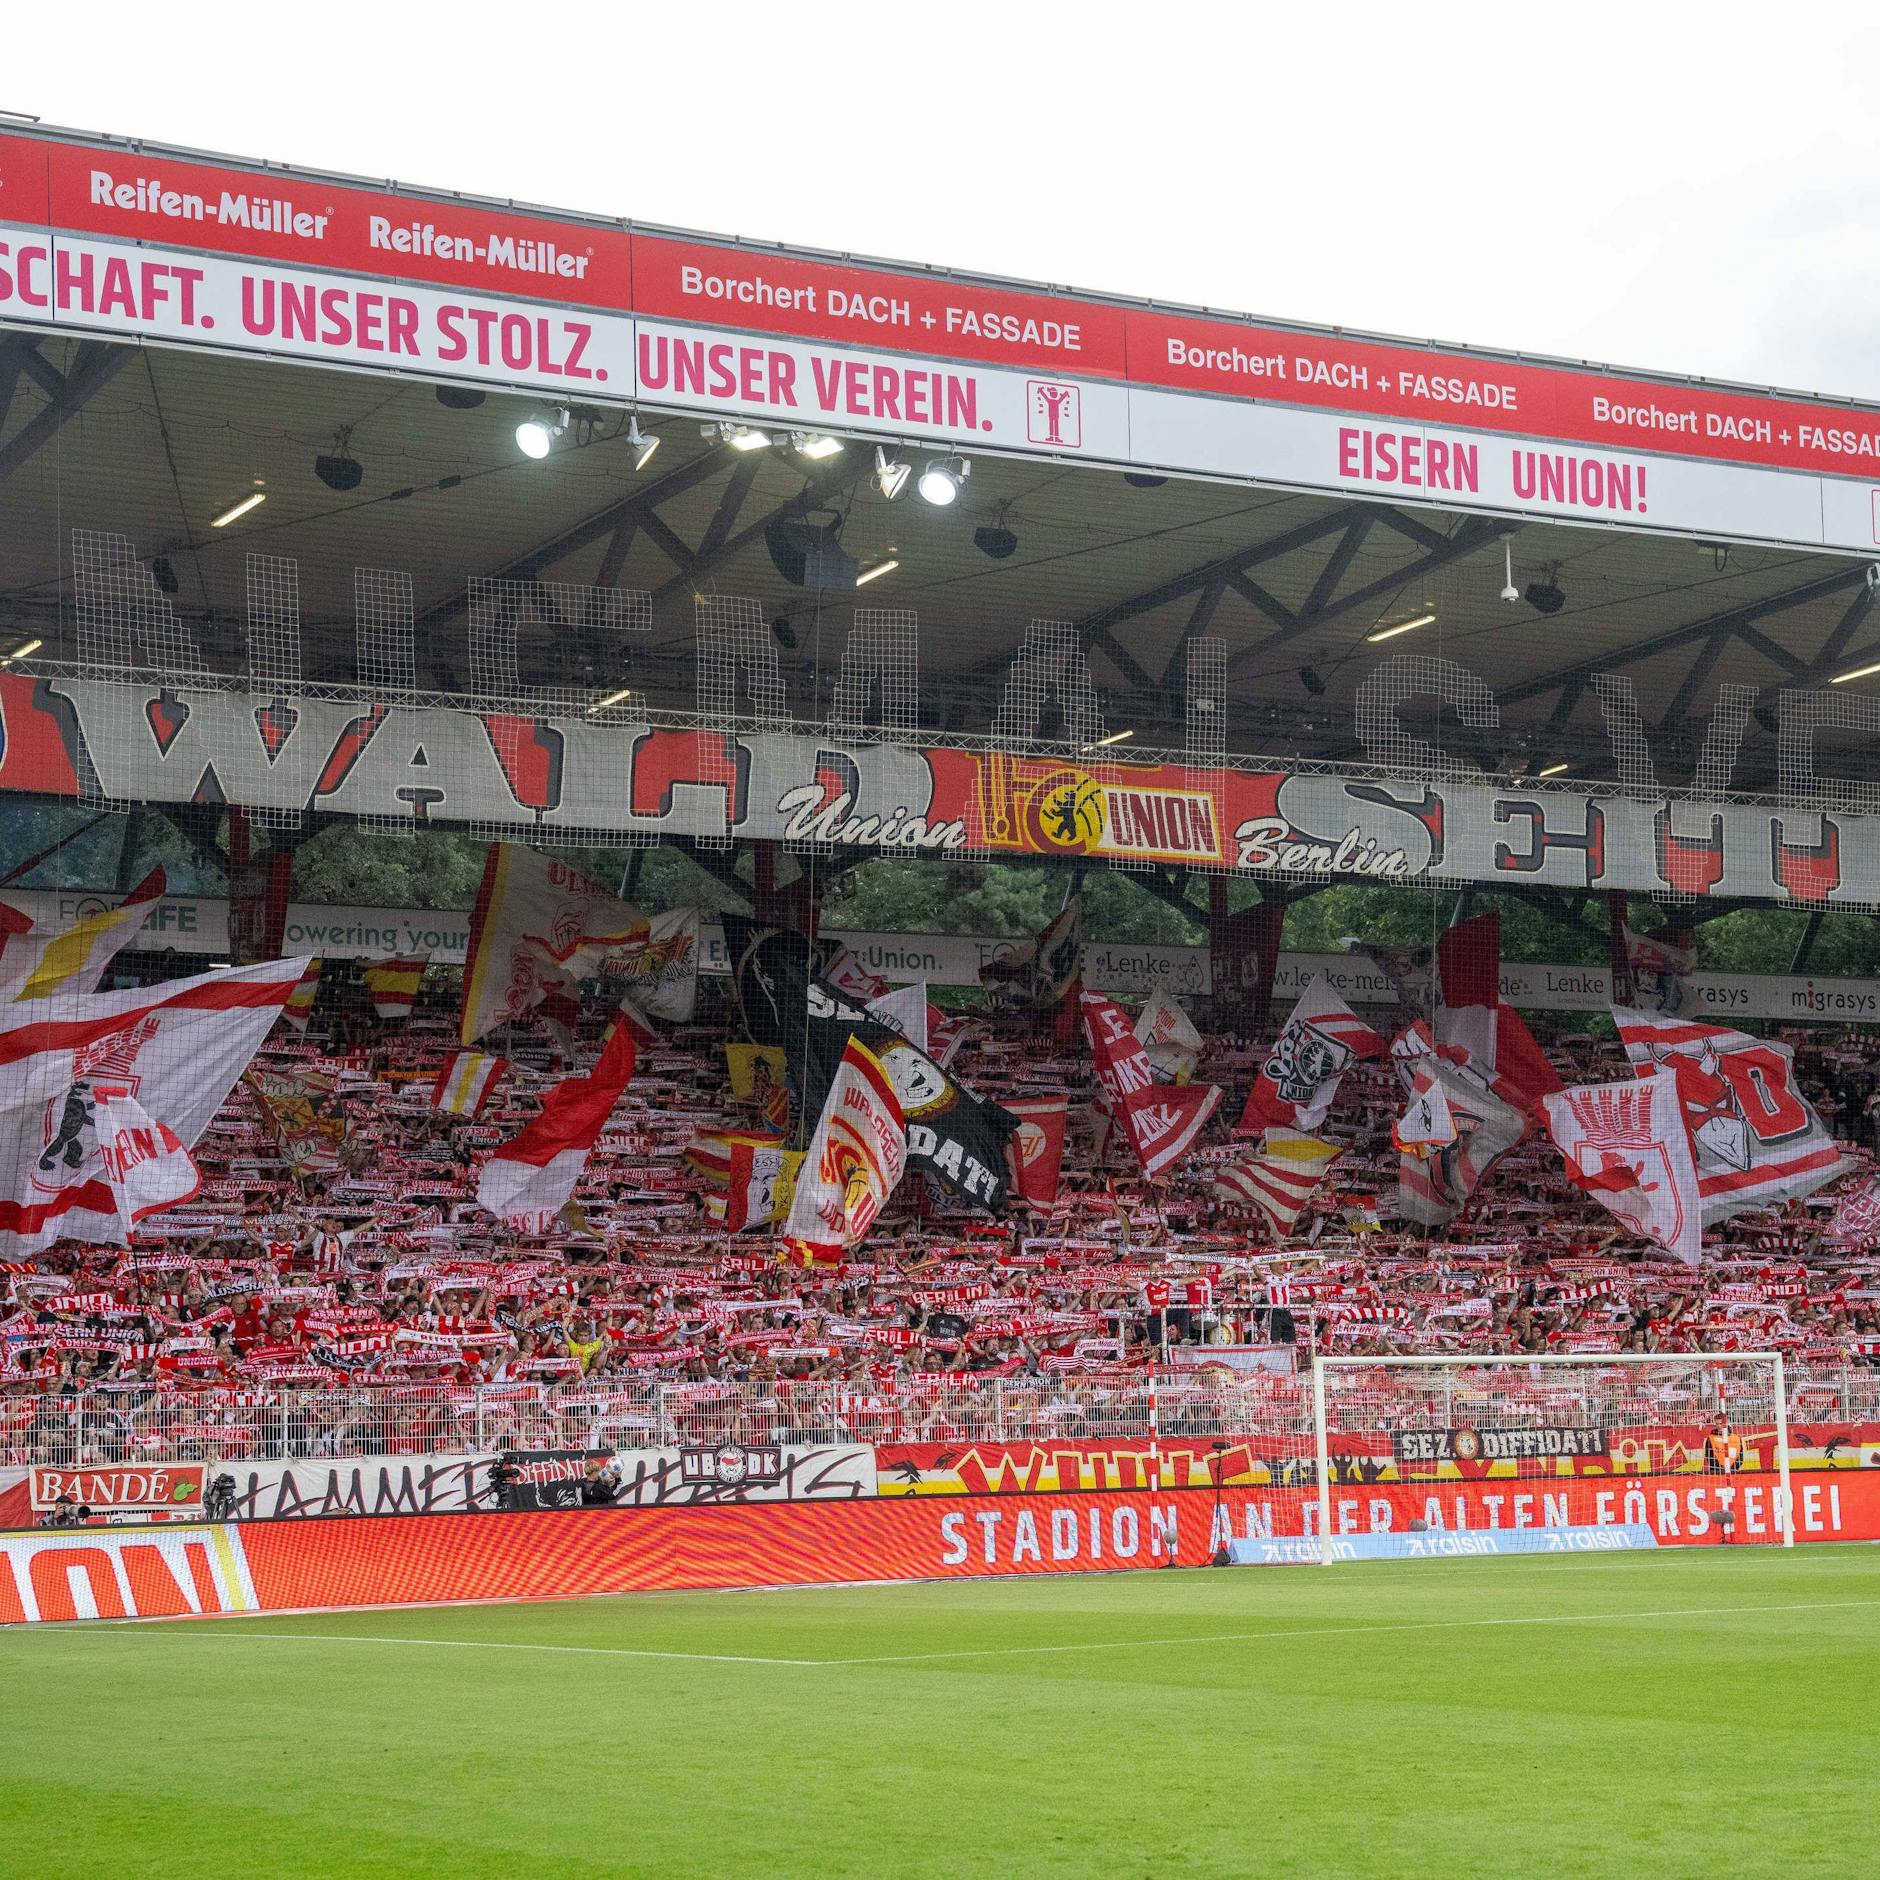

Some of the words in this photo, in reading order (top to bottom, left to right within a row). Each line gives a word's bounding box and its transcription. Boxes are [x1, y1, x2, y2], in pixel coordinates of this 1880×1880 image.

[90, 170, 328, 239] Reifen-Müller
[369, 216, 588, 279] Reifen-Müller
[242, 276, 420, 356] UNSER
[436, 305, 609, 381] STOLZ.
[681, 266, 816, 312] Borchert
[827, 290, 910, 326] DACH
[946, 308, 1081, 351] FASSADE
[638, 334, 799, 406] UNSER
[810, 356, 993, 432] VEREIN.
[1167, 338, 1286, 379] Borchert
[1295, 357, 1369, 390] DACH
[1399, 372, 1518, 410] FASSADE
[1593, 396, 1698, 434] Borchert
[1706, 414, 1771, 444] DACH
[1798, 424, 1880, 457] FASSA
[1339, 427, 1479, 493] EISERN
[1512, 450, 1648, 513] UNION!
[777, 785, 967, 850] Union
[1106, 790, 1218, 853] UNION
[1235, 815, 1407, 877] Berlin
[1277, 772, 1880, 904] SEIT
[141, 904, 197, 933] IFE
[287, 921, 398, 952] owering
[407, 929, 471, 952] your
[1105, 951, 1170, 974] Lenke
[1546, 971, 1604, 994] Lenke
[1697, 986, 1749, 1005] rasys
[1791, 981, 1876, 1010] migrasys
[907, 1123, 1000, 1204] DATI
[912, 1283, 988, 1305] BERLIN
[684, 1453, 716, 1476] UB
[1401, 1433, 1458, 1460] SEZ.
[1482, 1426, 1603, 1459] DIFFIDATI
[41, 1468, 169, 1504] BANDÉ
[942, 1505, 1180, 1566] STADION
[1424, 1492, 1568, 1532] ALTEN
[1595, 1480, 1842, 1538] FÖRSTEREI
[1423, 1531, 1499, 1556] raisin
[1563, 1525, 1632, 1550] raisin
